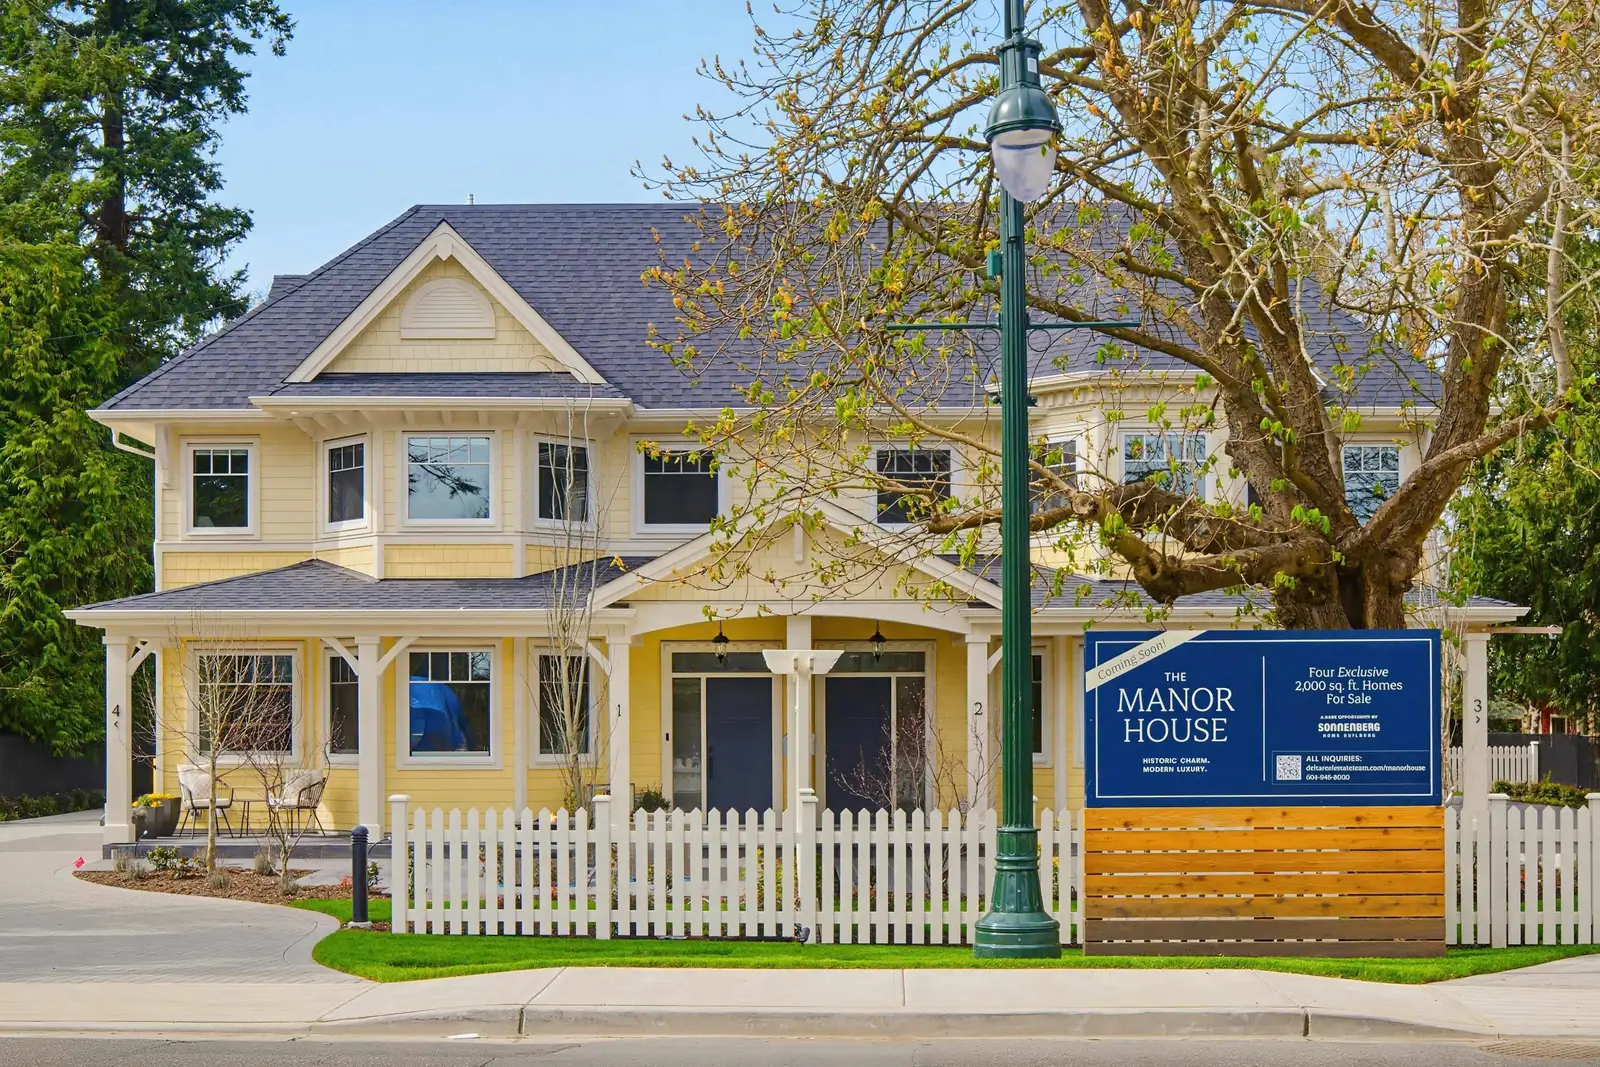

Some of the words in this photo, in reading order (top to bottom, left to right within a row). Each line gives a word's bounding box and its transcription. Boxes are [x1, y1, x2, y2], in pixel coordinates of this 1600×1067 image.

[1098, 656, 1138, 680] Coming
[1138, 638, 1167, 660] Soon!
[1164, 672, 1186, 682] THE
[1309, 667, 1334, 678] Four
[1338, 666, 1388, 678] Exclusive
[1295, 680, 1326, 692] 2,000
[1329, 682, 1344, 692] sq.
[1348, 680, 1359, 690] ft.
[1362, 680, 1402, 690] Homes
[1116, 687, 1235, 712] MANOR
[1326, 694, 1345, 704] For
[1348, 693, 1372, 704] Sale
[112, 704, 120, 716] 4
[617, 704, 621, 716] 1
[974, 702, 983, 716] 2
[1474, 699, 1482, 712] 3
[1124, 718, 1228, 742] HOUSE
[1318, 722, 1380, 732] SONNENBERG
[1322, 755, 1362, 763] INQUIRIES:
